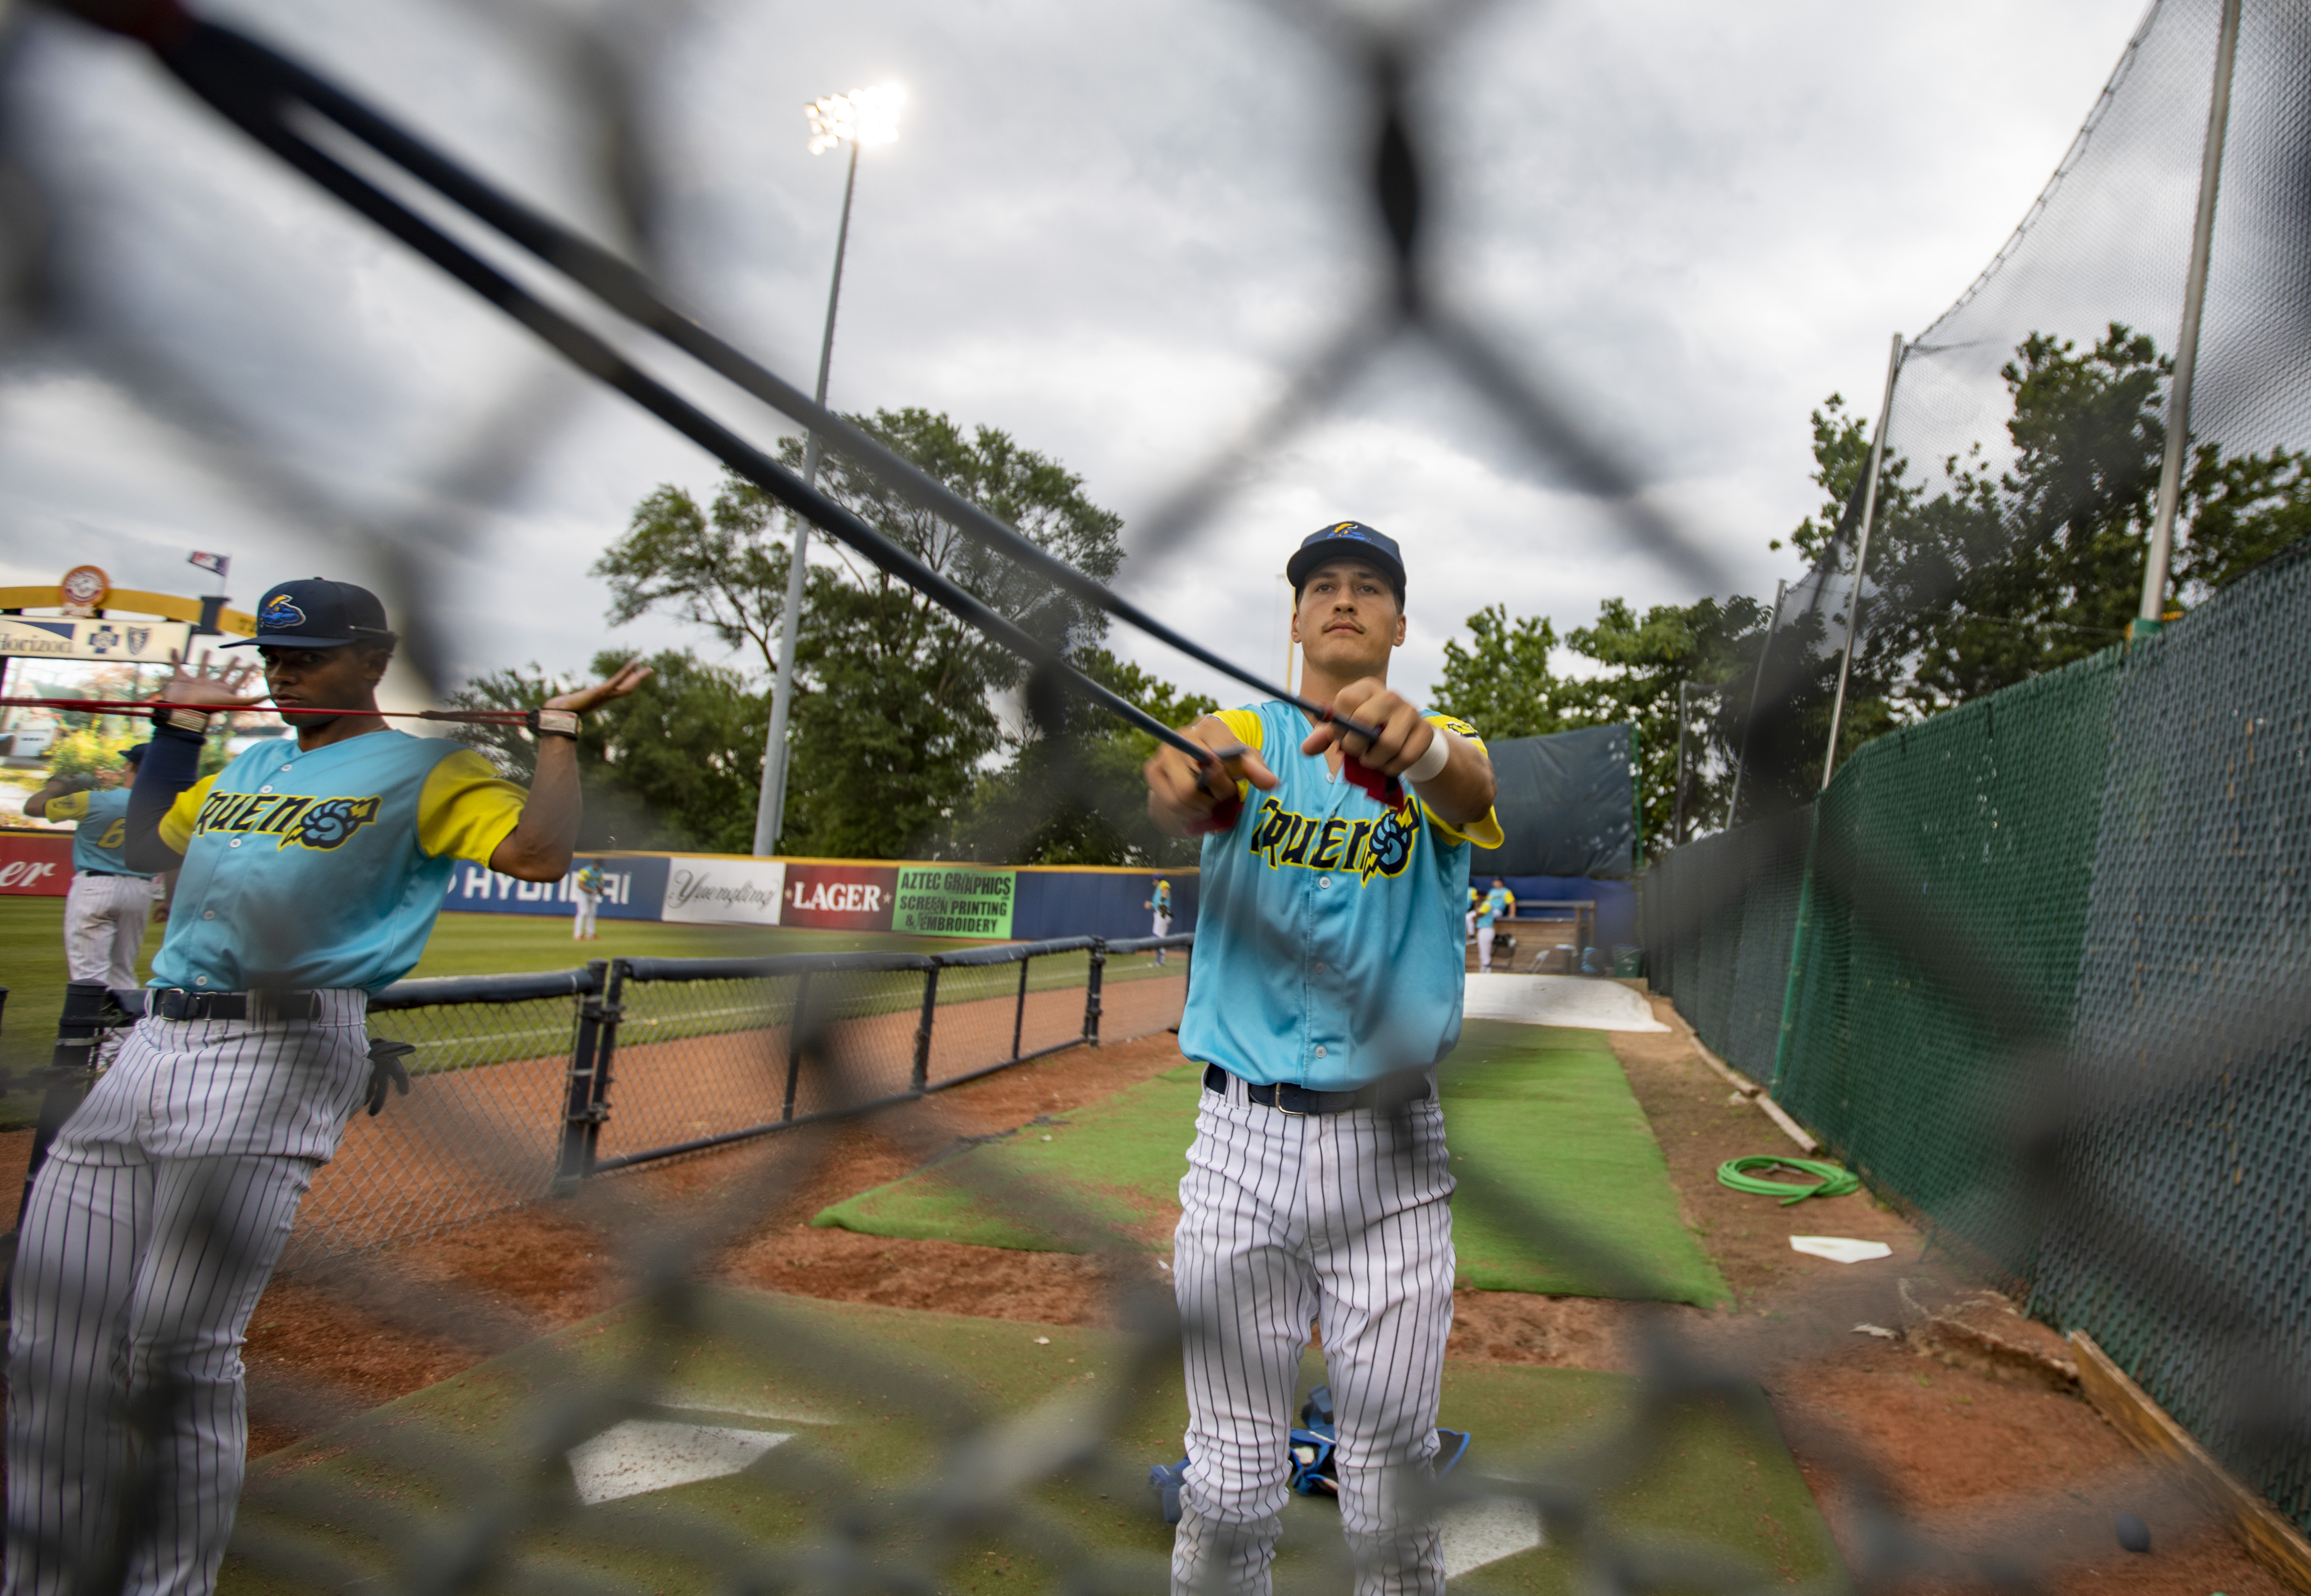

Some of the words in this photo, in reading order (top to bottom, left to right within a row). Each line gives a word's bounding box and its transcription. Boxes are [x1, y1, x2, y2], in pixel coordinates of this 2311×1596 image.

[667, 869, 780, 913] Yuengling
[901, 872, 941, 890] AZTEC
[944, 872, 1011, 895] GRAPHICS
[793, 881, 882, 912] LAGER
[899, 895, 948, 915] SCREEN
[951, 900, 1007, 916] PRINTING
[918, 913, 998, 934] EMBROIDERY
